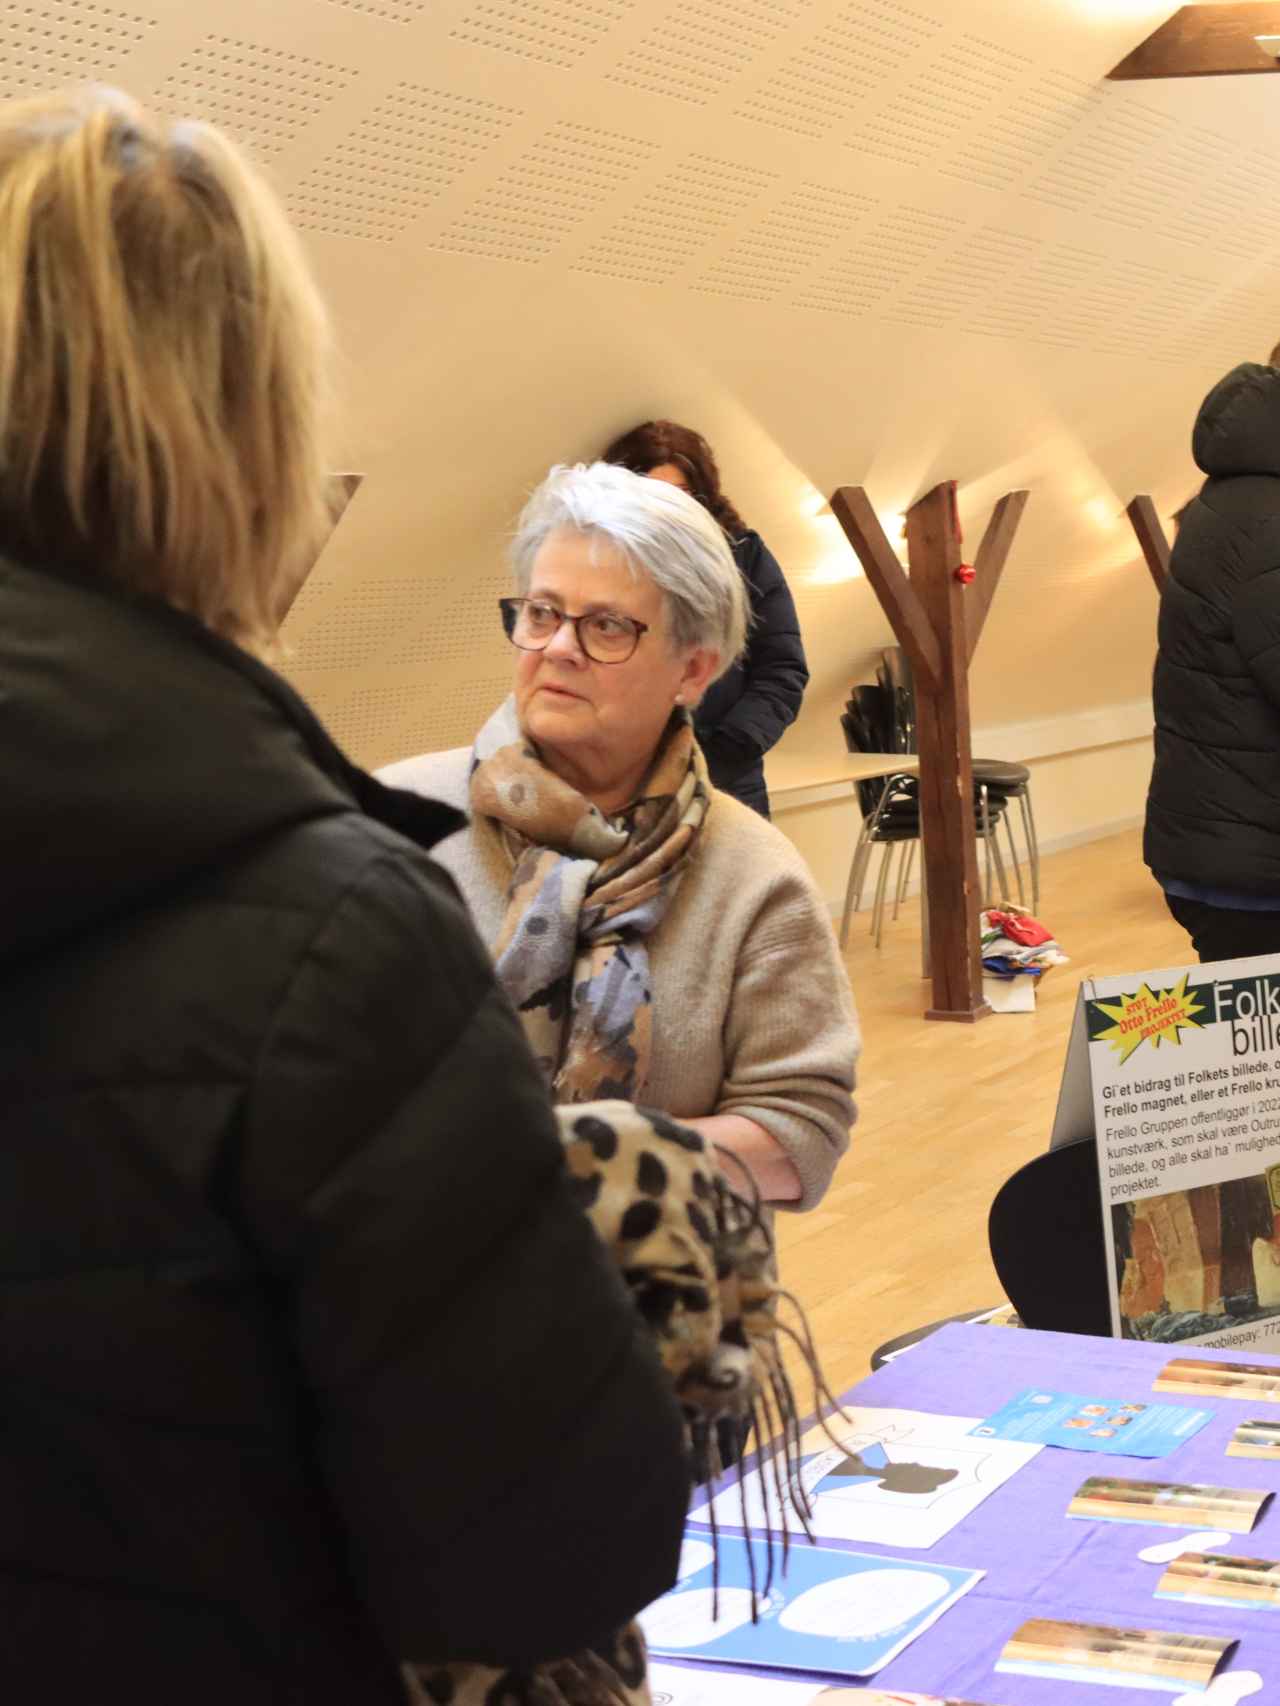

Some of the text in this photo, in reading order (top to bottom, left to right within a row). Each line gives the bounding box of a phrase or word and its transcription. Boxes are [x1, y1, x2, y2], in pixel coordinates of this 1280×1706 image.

[1134, 1079, 1171, 1094] bidrag
[1174, 1073, 1185, 1087] til
[1188, 1068, 1229, 1084] Folkets
[1232, 1061, 1272, 1077] billede,
[1104, 1102, 1138, 1118] Frello
[1191, 1088, 1215, 1103] eller
[1217, 1085, 1229, 1098] et
[1231, 1080, 1263, 1096] Frello
[1105, 1125, 1138, 1141] Frello
[1140, 1117, 1188, 1135] Gruppen
[1191, 1105, 1250, 1126] offentliggør
[1171, 1134, 1194, 1147] som
[1197, 1127, 1218, 1142] skal
[1221, 1122, 1248, 1137] være
[1152, 1158, 1166, 1171] og
[1169, 1152, 1188, 1167] alle
[1190, 1145, 1213, 1162] skal
